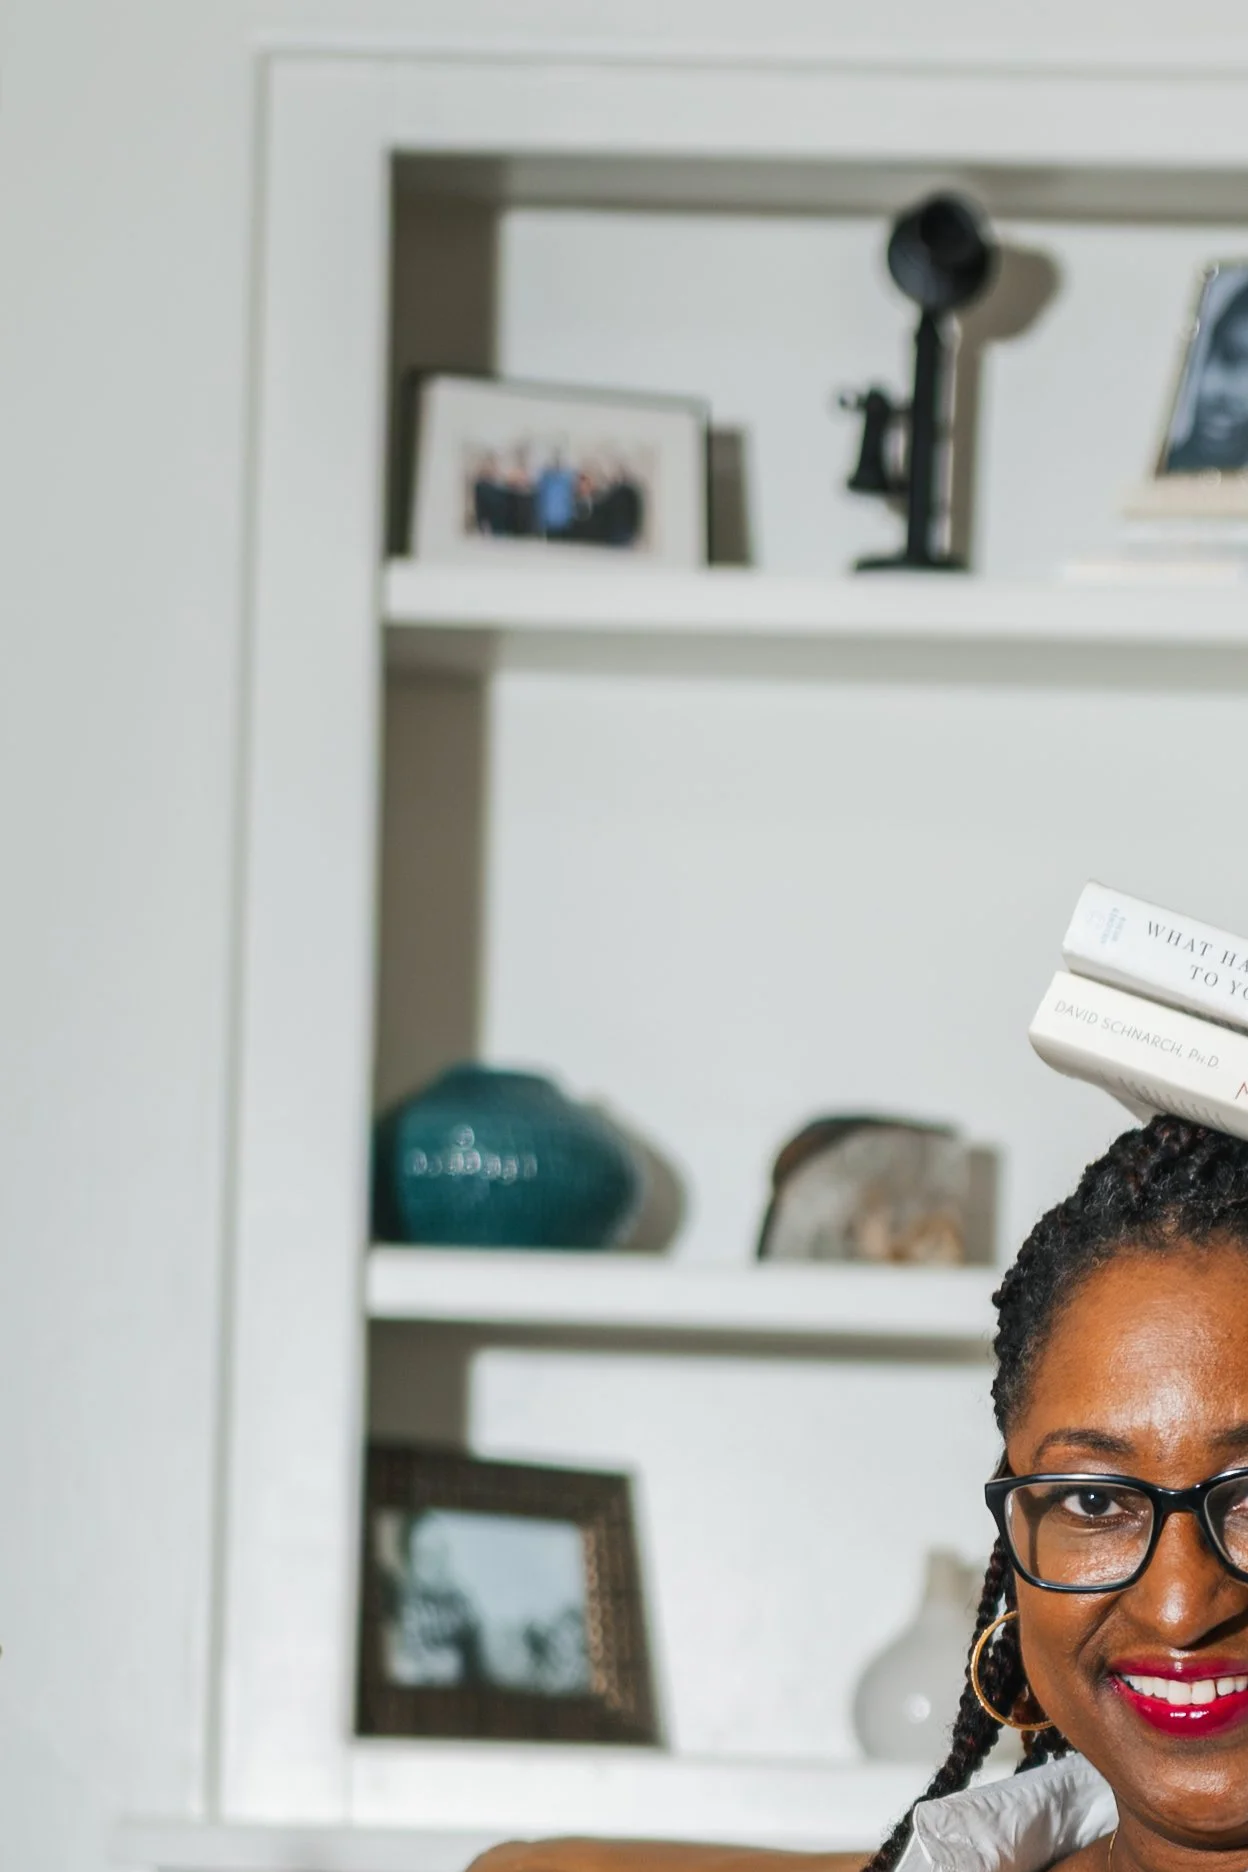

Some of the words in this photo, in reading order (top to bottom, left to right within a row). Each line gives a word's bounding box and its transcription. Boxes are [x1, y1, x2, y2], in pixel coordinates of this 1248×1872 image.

[1146, 921, 1213, 957] WHAT
[1189, 965, 1219, 988] TO
[1054, 1000, 1099, 1024] DAVID
[1101, 1018, 1183, 1058] SCHNARCH,
